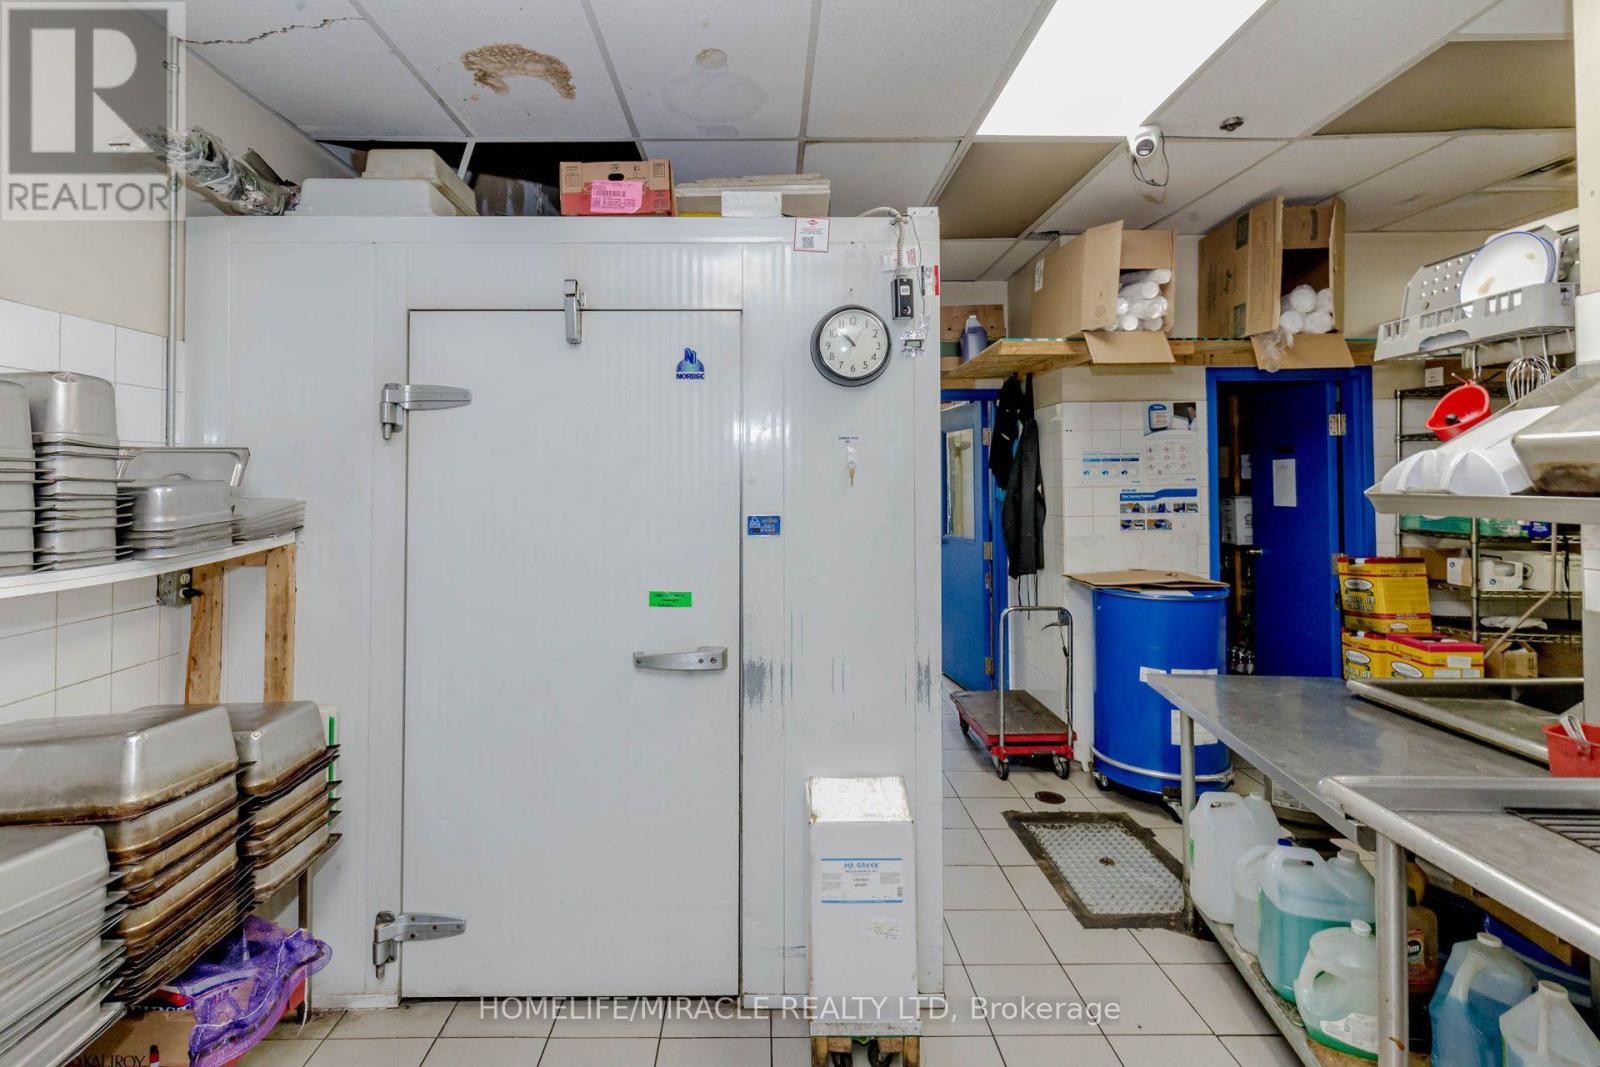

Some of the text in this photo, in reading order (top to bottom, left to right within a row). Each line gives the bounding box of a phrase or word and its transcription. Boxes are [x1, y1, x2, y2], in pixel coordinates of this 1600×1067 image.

[838, 320, 845, 329] 11
[849, 316, 857, 326] 12
[872, 328, 879, 339] 2
[825, 341, 831, 350] 9
[875, 341, 881, 351] 3
[829, 352, 835, 361] 8
[871, 353, 877, 361] 4
[838, 360, 844, 369] 7
[850, 363, 856, 373] 6
[863, 361, 869, 370] 5
